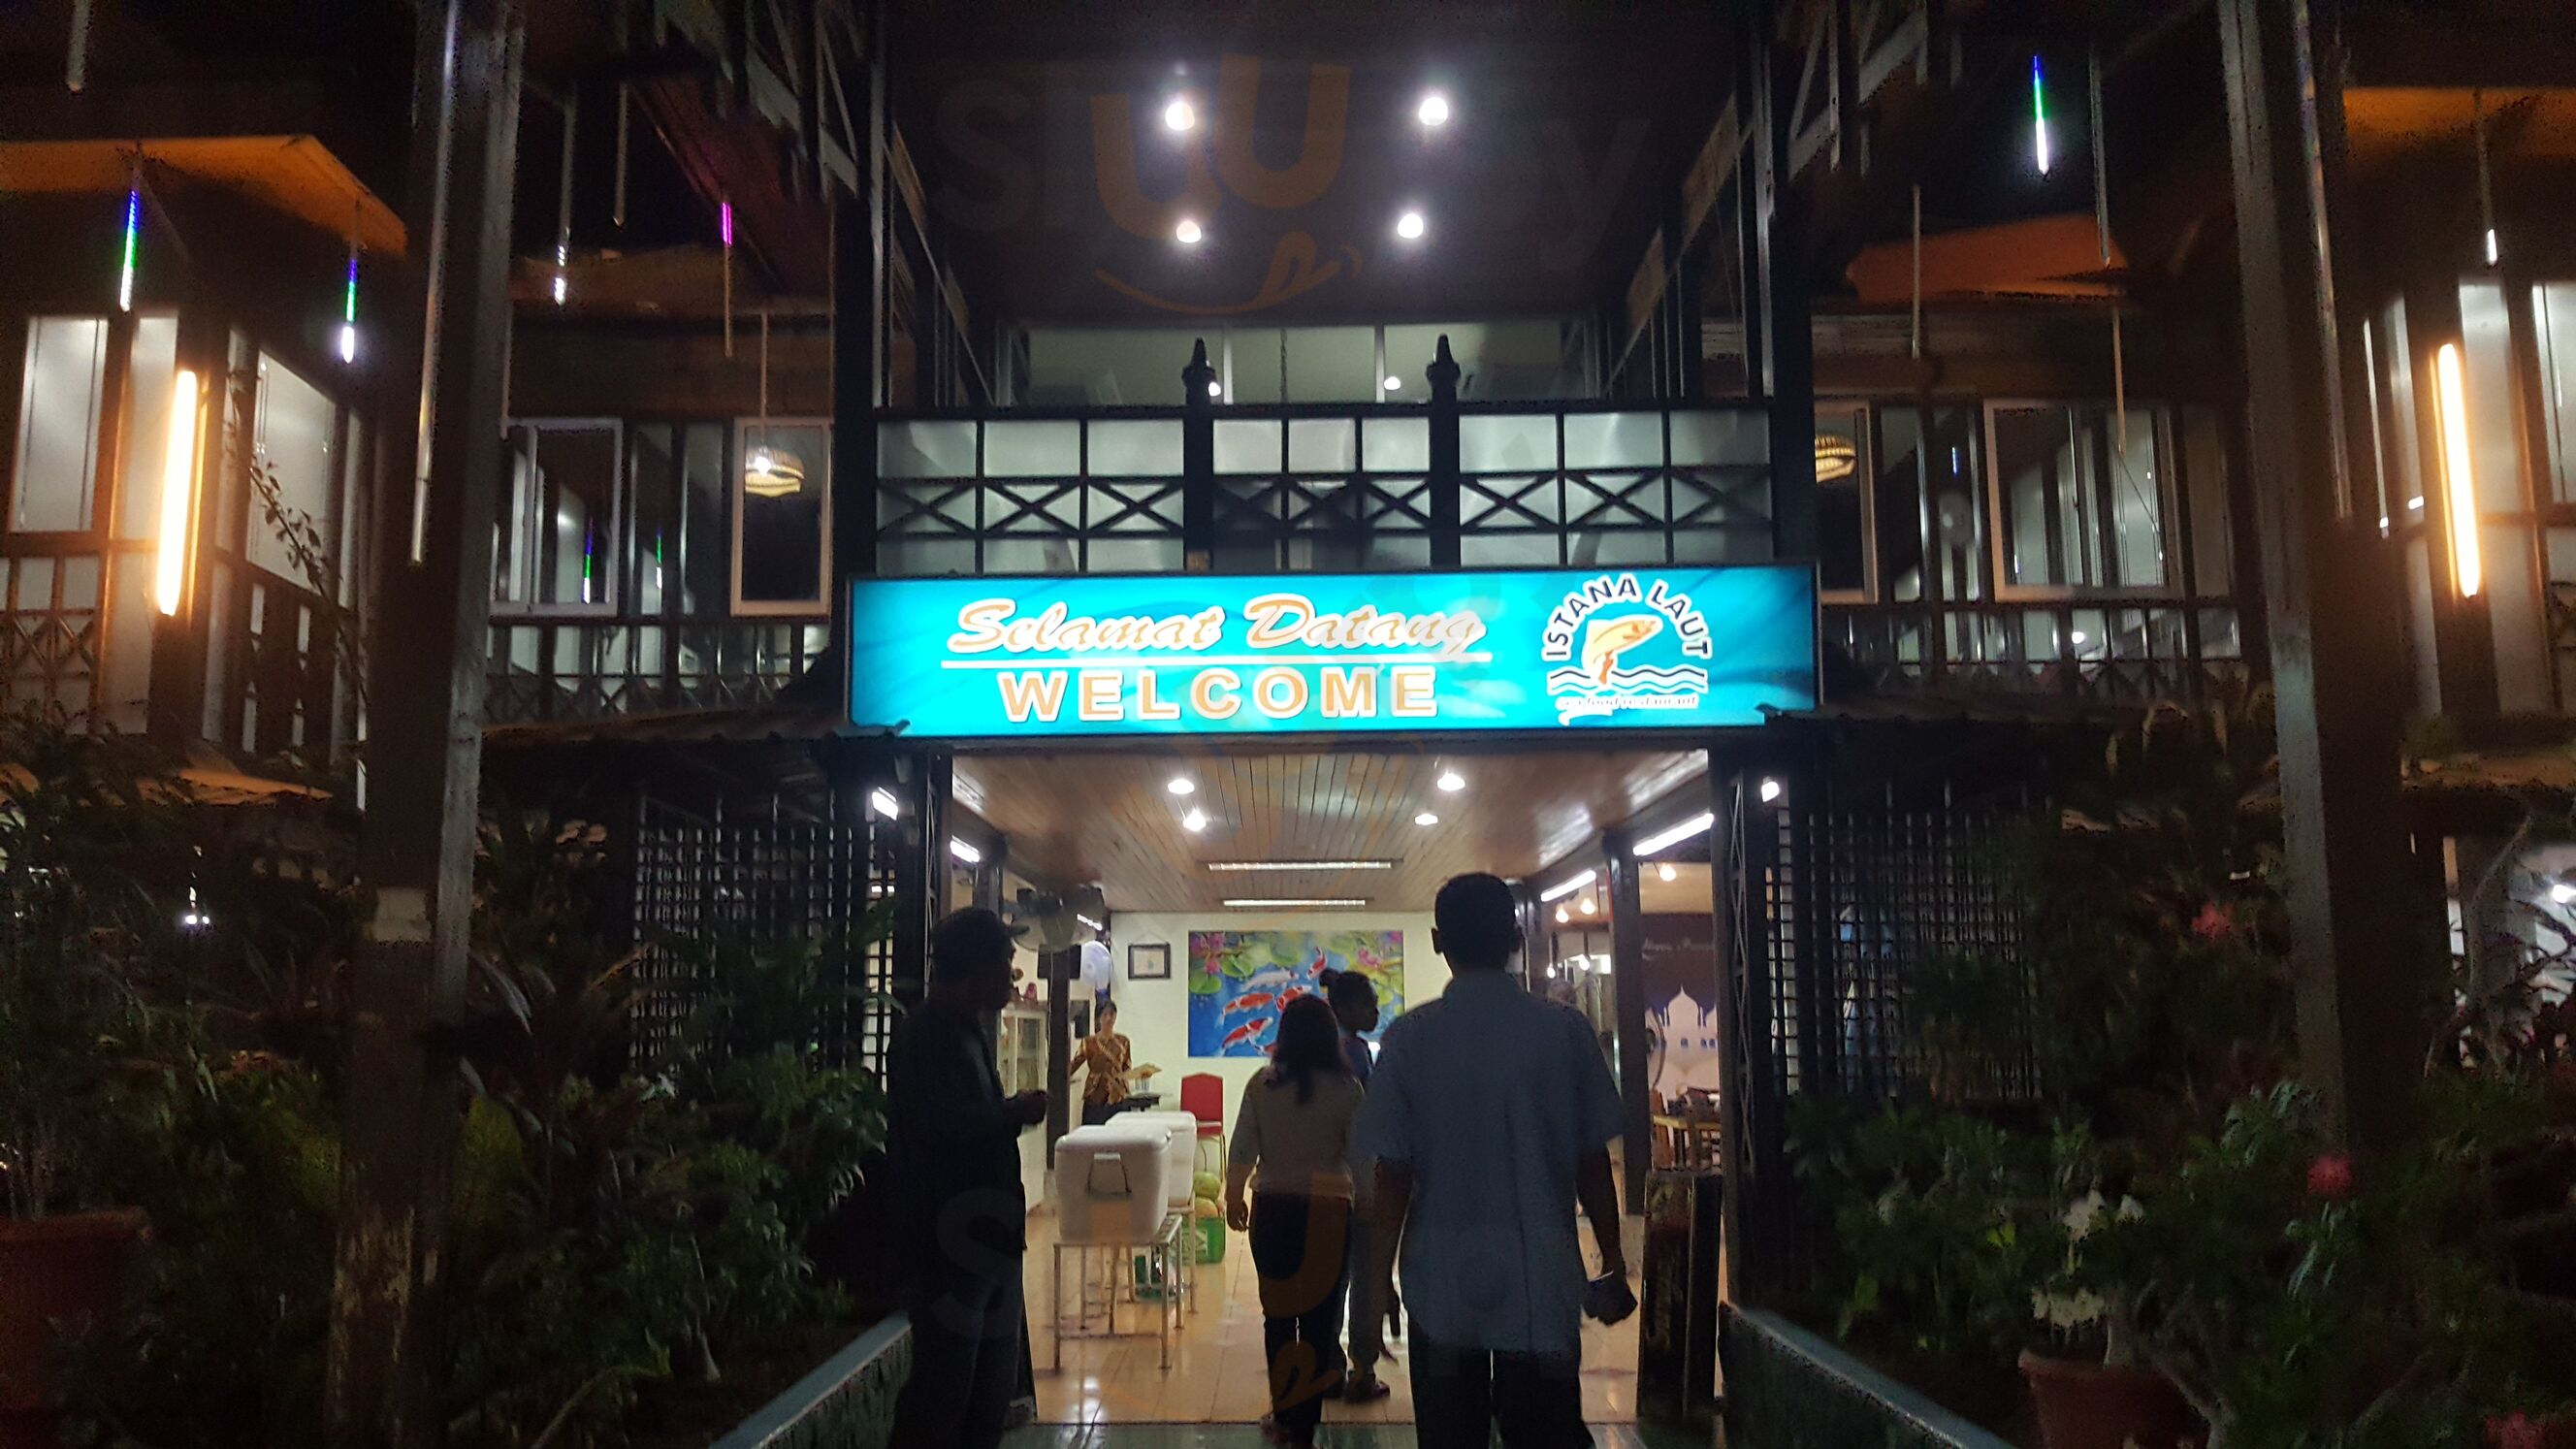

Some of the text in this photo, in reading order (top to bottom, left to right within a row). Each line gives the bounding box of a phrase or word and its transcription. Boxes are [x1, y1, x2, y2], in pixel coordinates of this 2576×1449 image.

[947, 594, 1487, 657] Selamat Datang
[1544, 576, 1709, 658] ISTANA LAUT
[998, 666, 1436, 722] WELCOME
